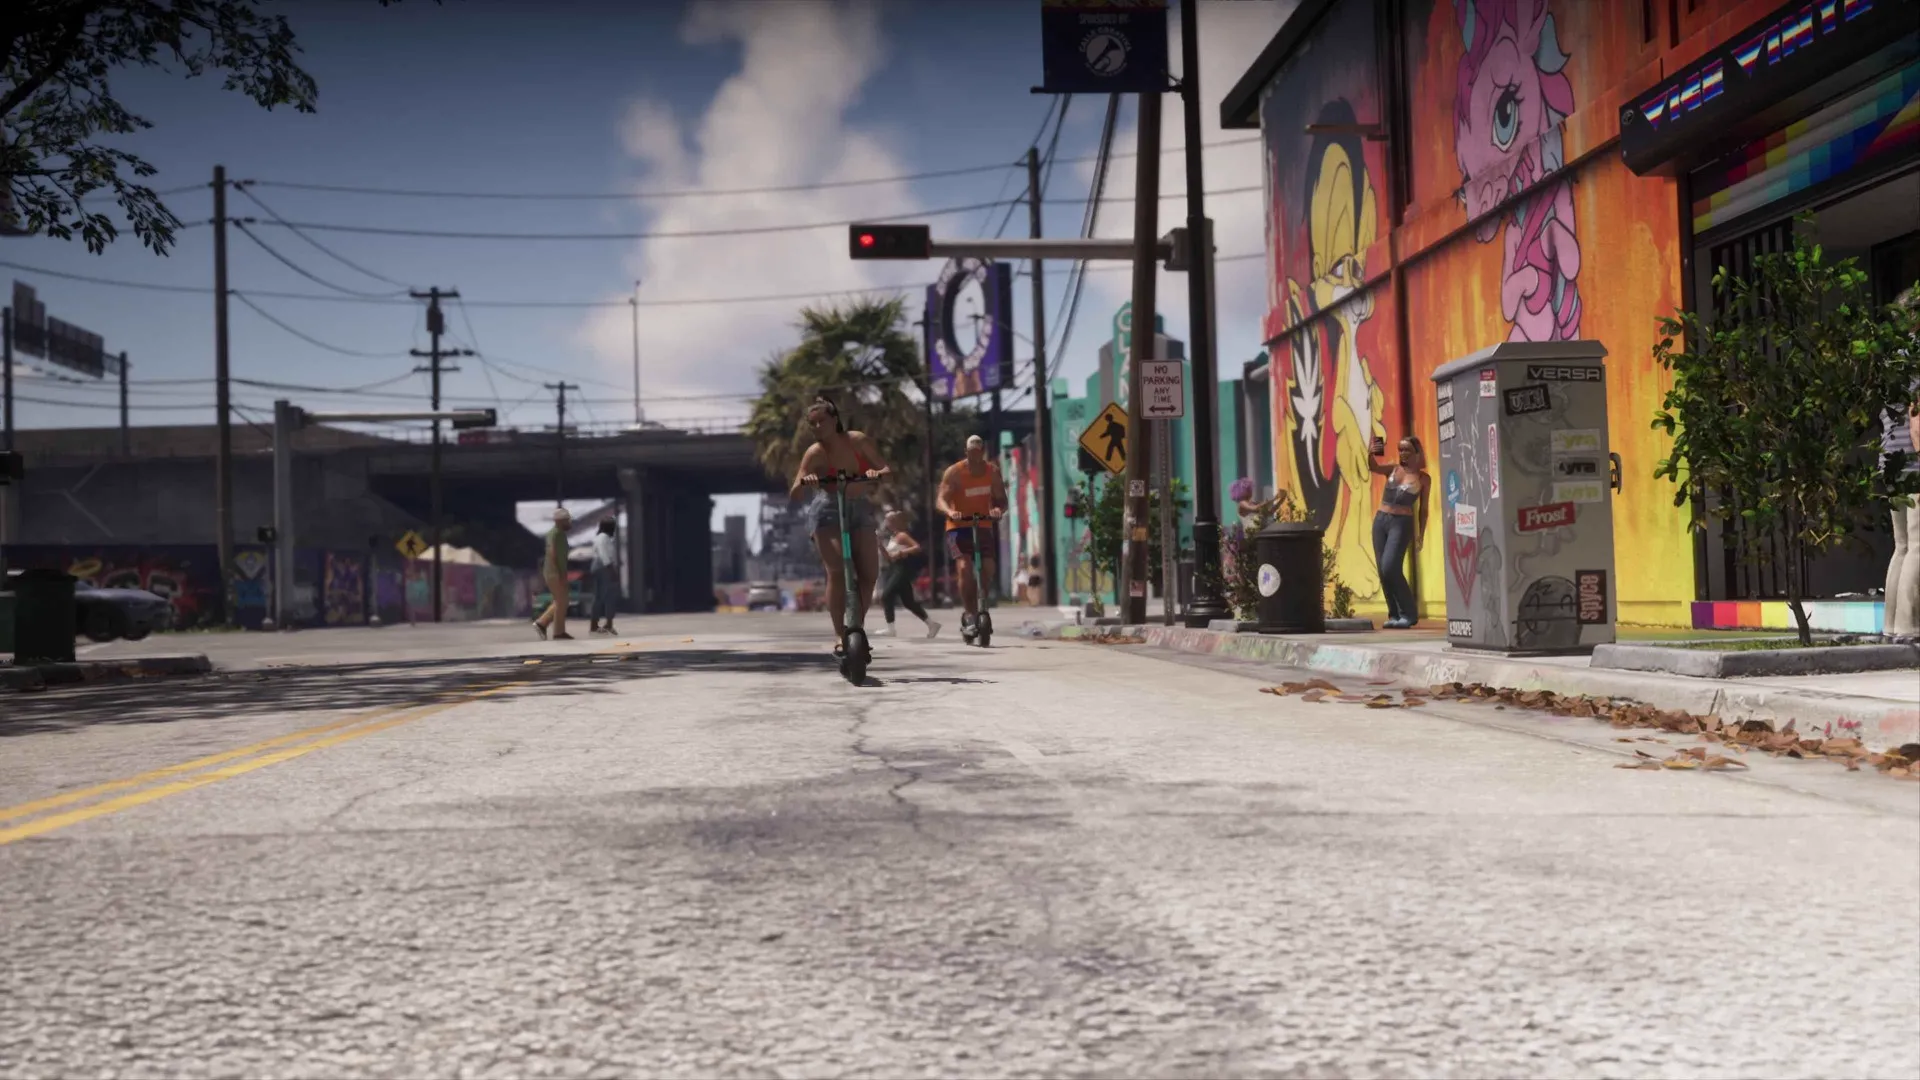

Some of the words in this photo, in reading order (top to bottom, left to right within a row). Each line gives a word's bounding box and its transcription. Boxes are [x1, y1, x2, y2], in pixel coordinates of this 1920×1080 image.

[1640, 58, 1724, 131] VICE
[1154, 365, 1168, 374] NO
[1530, 367, 1600, 380] VERSA
[1143, 375, 1180, 385] PARKING
[1153, 386, 1170, 395] ANY
[1153, 395, 1172, 403] TIME
[1457, 511, 1475, 525] FROST
[1524, 506, 1567, 526] Frost
